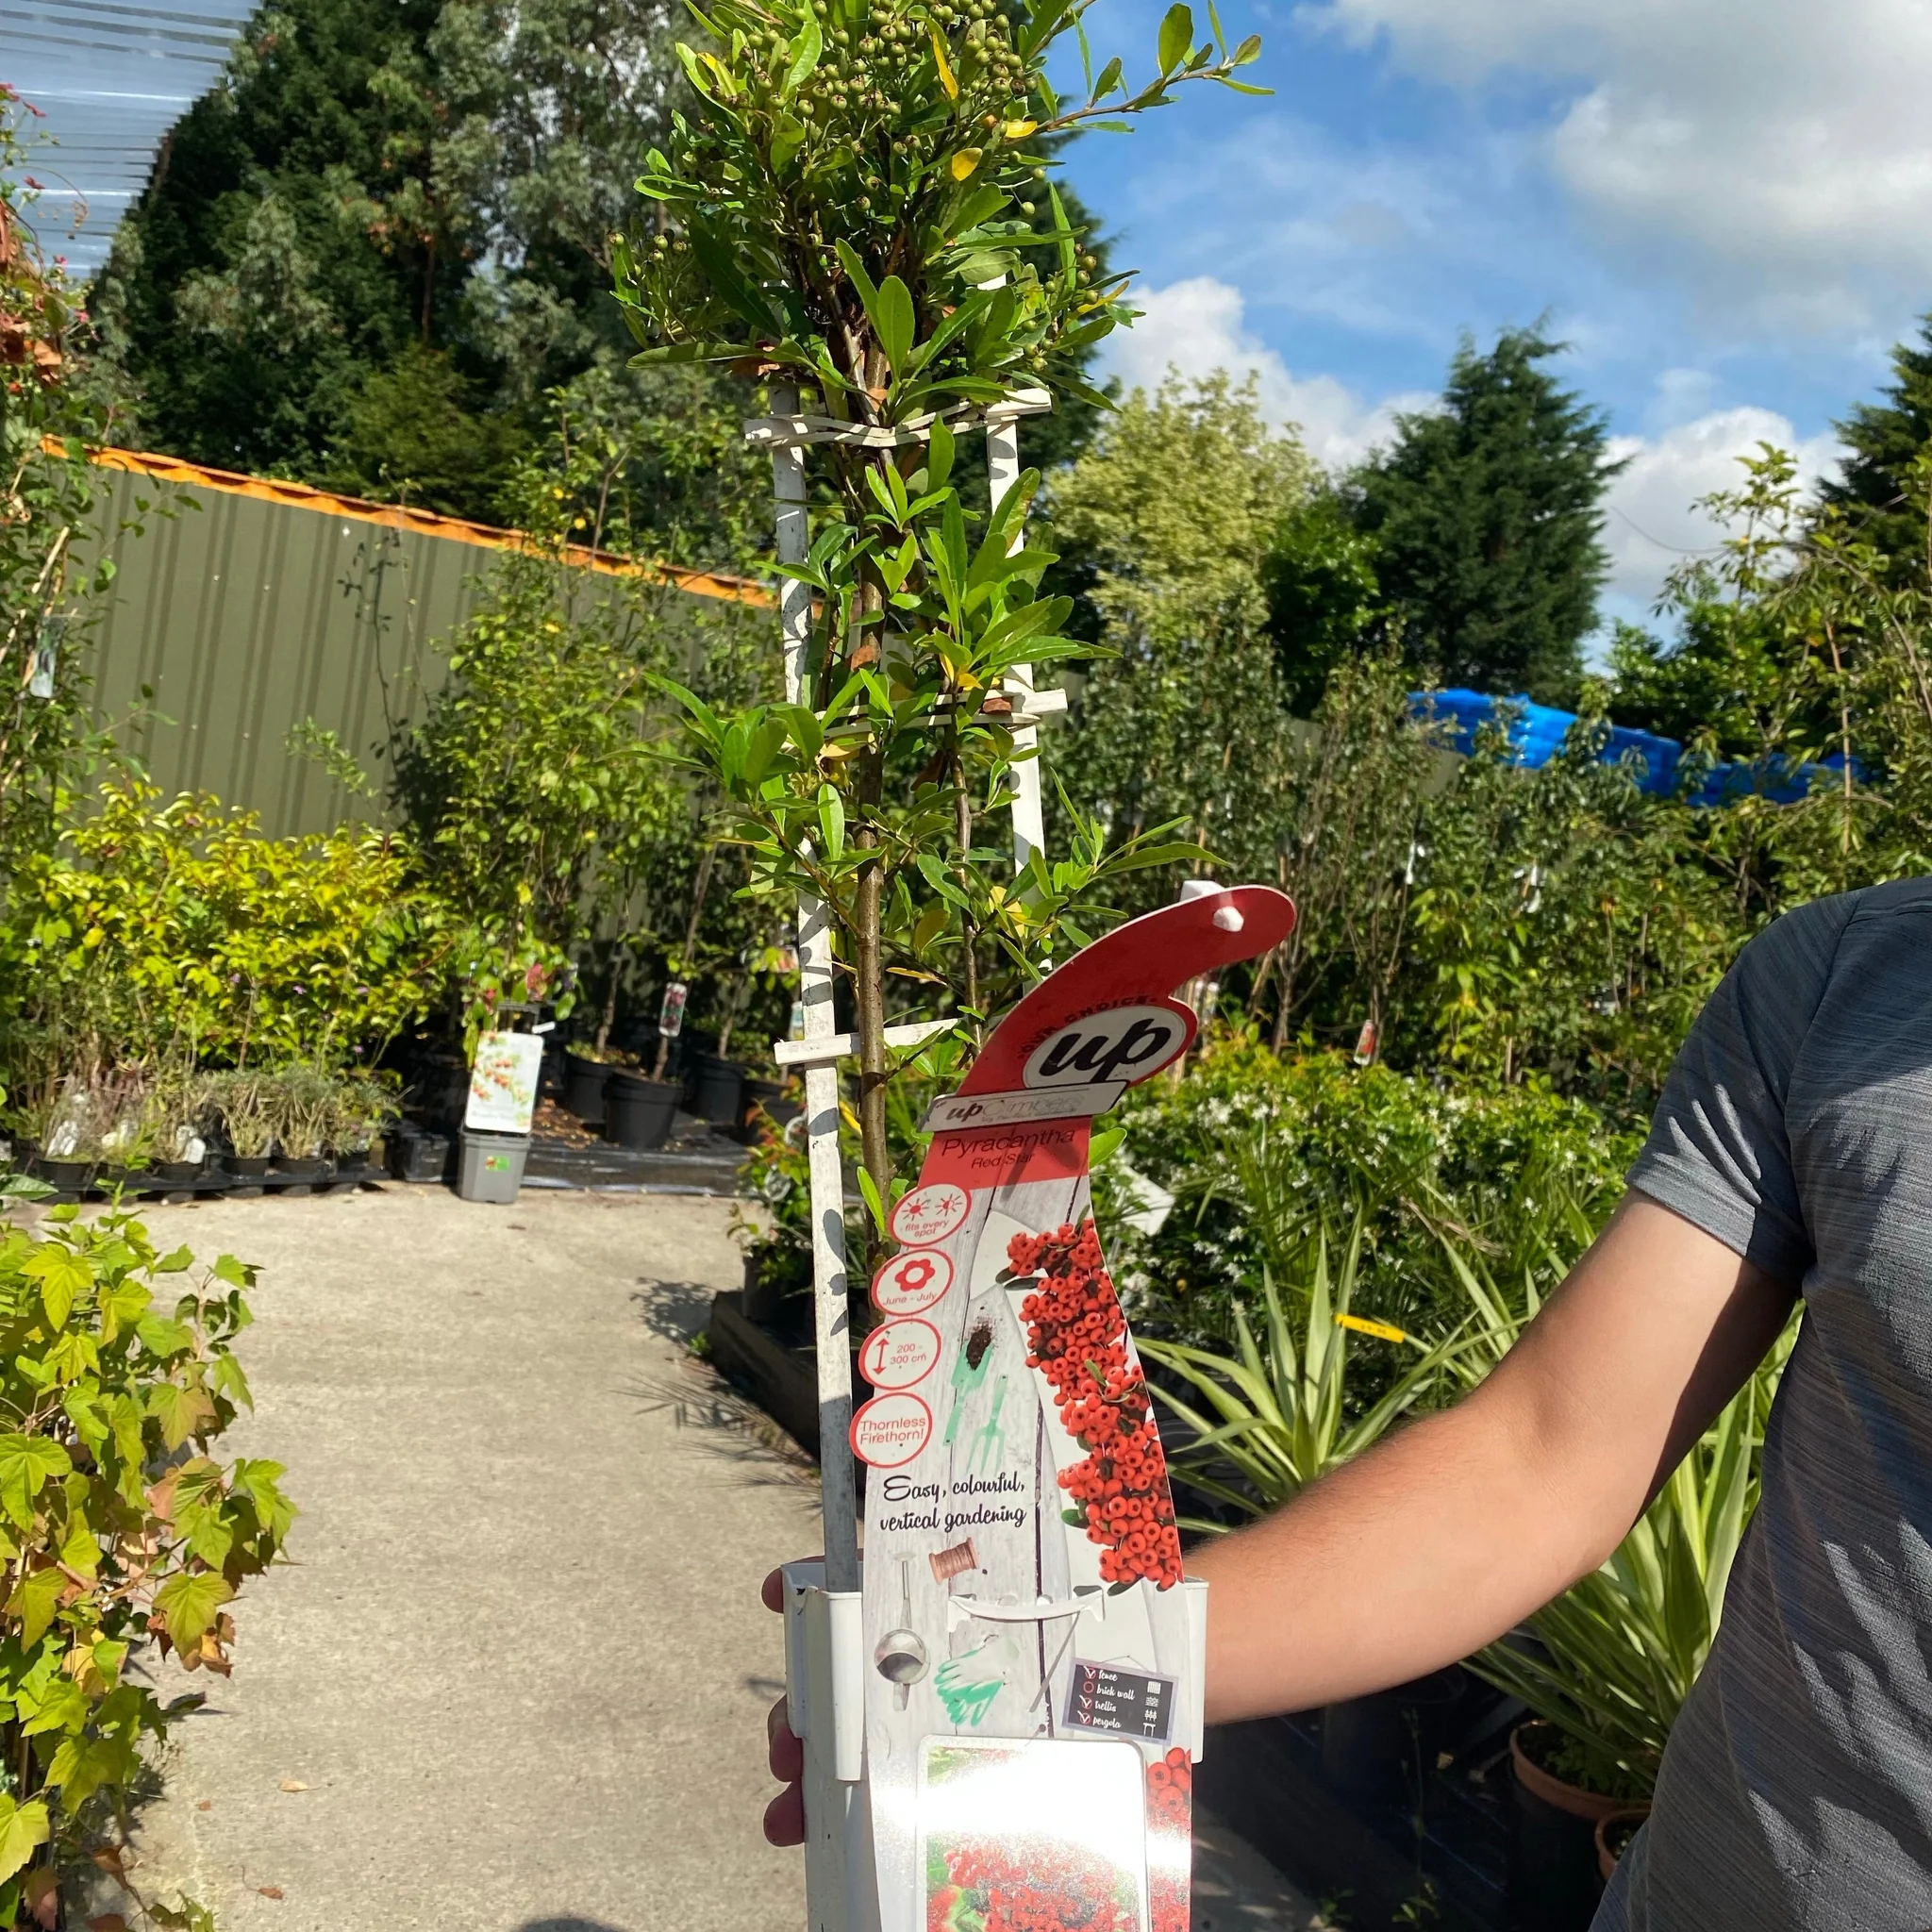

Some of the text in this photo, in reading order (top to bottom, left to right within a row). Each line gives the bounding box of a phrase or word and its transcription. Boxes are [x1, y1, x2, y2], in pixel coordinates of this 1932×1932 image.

[1039, 1018, 1172, 1083] up
[942, 1129, 1075, 1158] Pyracantha
[971, 1152, 1035, 1169] Red Star
[923, 1220, 950, 1229] every
[914, 1228, 937, 1238] spot
[883, 1296, 908, 1306] June
[917, 1291, 937, 1302] July
[896, 1343, 916, 1354] 200
[890, 1354, 926, 1365] 300 cm
[859, 1417, 925, 1432] Thornless
[859, 1428, 924, 1445] Firethorn!
[883, 1471, 1025, 1504] Easy, colourful,
[880, 1503, 1027, 1534] vertical gardening
[1098, 1669, 1118, 1682] fence
[1096, 1684, 1136, 1701] brick wall
[1094, 1699, 1117, 1712] trellis
[1092, 1716, 1122, 1729] pergola
